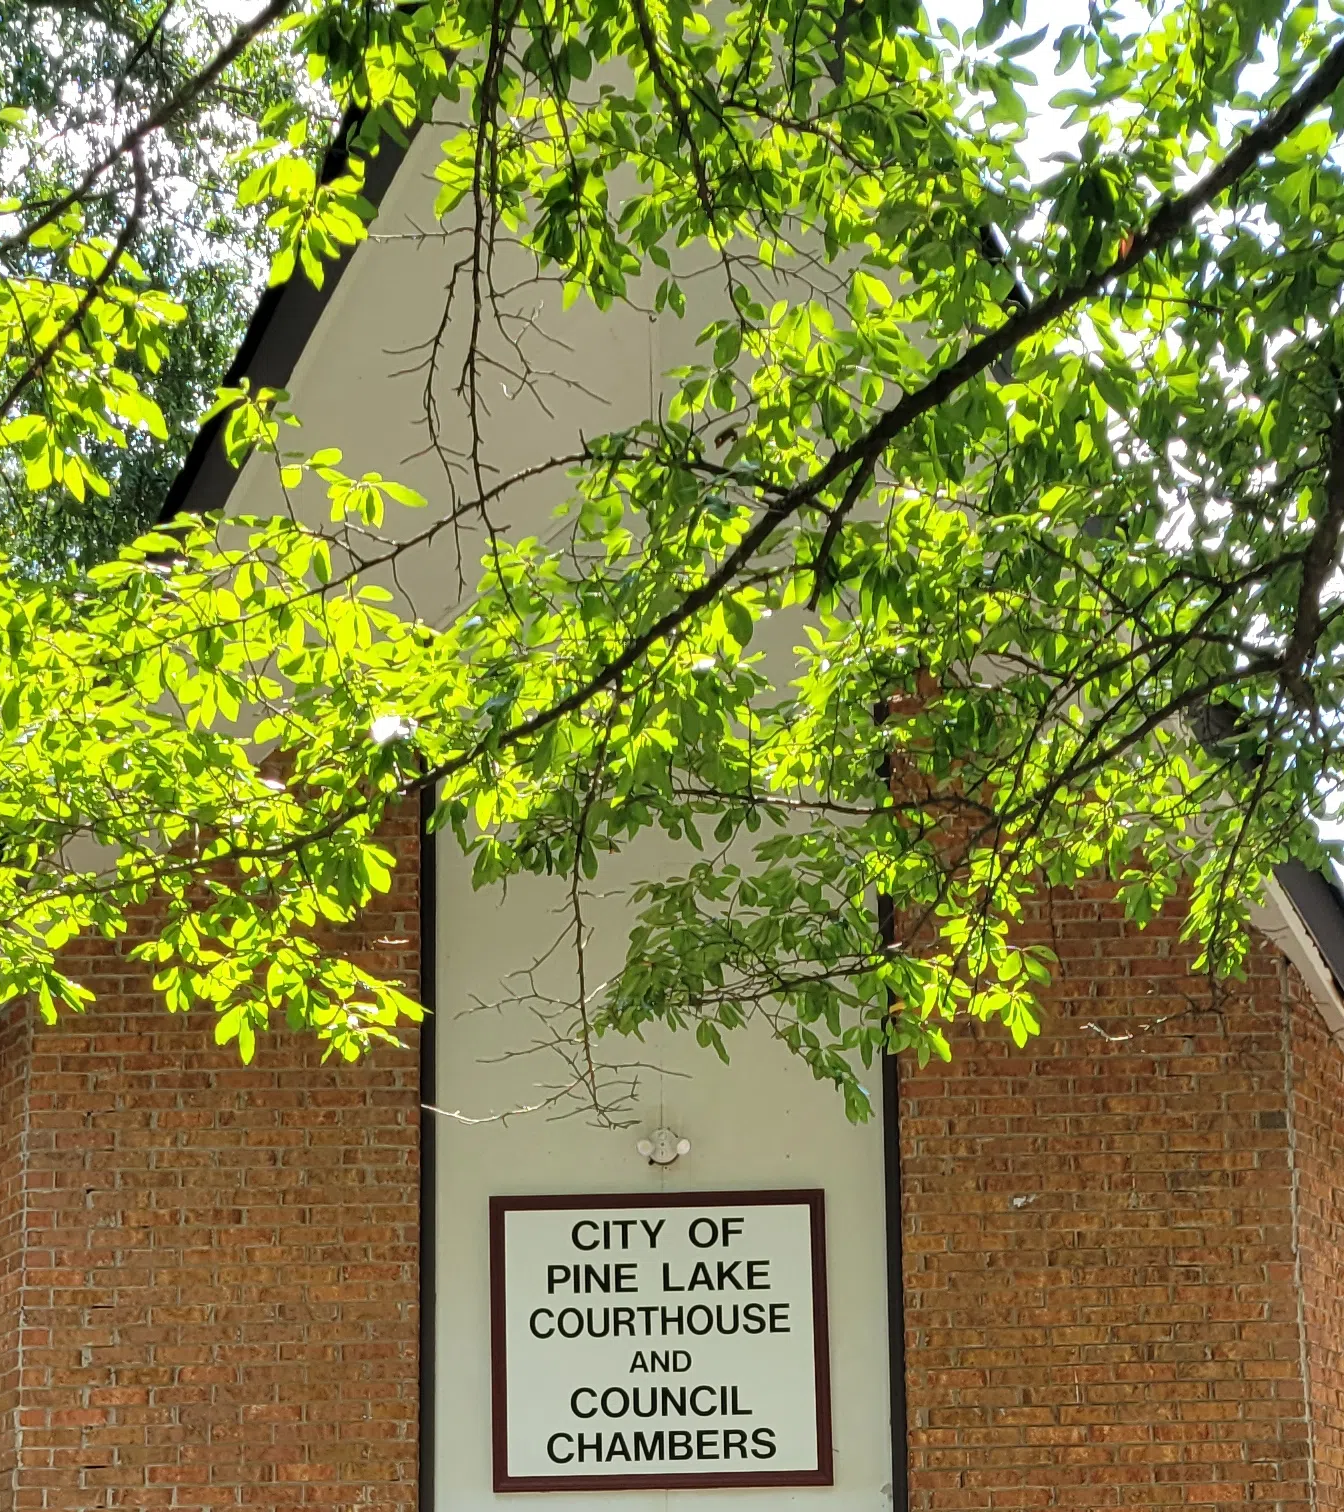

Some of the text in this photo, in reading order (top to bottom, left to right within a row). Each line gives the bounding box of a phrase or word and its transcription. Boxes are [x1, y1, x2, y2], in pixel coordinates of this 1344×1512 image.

[571, 1217, 745, 1251] CITY OF
[547, 1260, 771, 1294] PINE LAKE
[529, 1303, 791, 1339] COURTHOUSE
[629, 1350, 692, 1373] AND
[570, 1385, 753, 1419] COUNCIL
[546, 1428, 776, 1464] CHAMBERS
